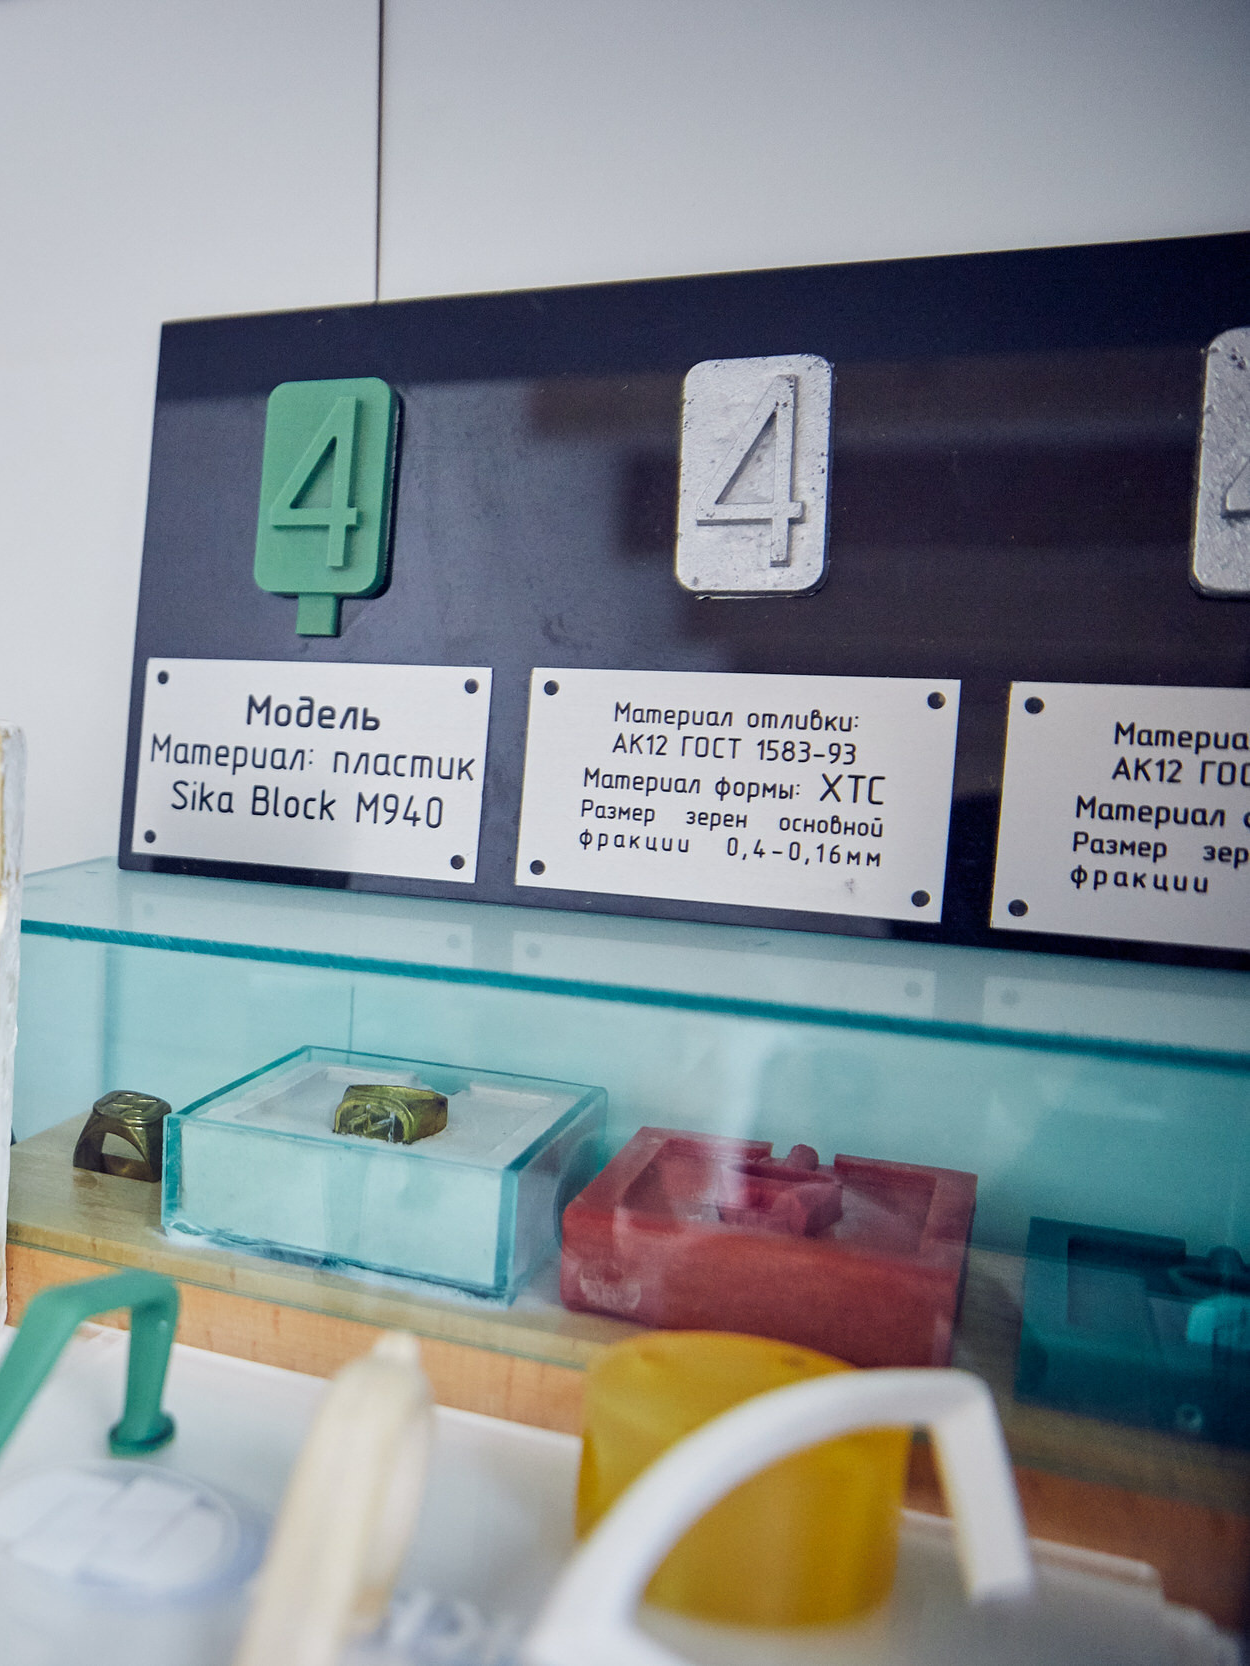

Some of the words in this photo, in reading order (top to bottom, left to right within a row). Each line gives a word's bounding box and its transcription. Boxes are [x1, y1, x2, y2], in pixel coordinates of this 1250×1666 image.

[270, 397, 358, 568] 4
[697, 375, 804, 567] 4
[247, 695, 380, 731] Модель
[615, 702, 732, 730] Материал
[748, 710, 858, 732] отливки:
[151, 734, 313, 775] Материал:
[333, 751, 475, 781] пластик
[612, 733, 667, 755] АК12
[682, 736, 742, 759] ГОСТ
[757, 740, 856, 765] 1583-93
[584, 767, 700, 796] Материал
[715, 777, 800, 803] формы:
[820, 774, 885, 805] ХТС
[1112, 757, 1182, 783] АК12
[171, 780, 234, 813] Sika
[252, 785, 335, 821] Block
[356, 792, 443, 828] M940
[581, 799, 655, 826] Размер
[686, 811, 747, 831] зерен
[780, 815, 883, 837] основной
[1076, 795, 1225, 829] Материал
[580, 829, 689, 852] фракции
[1073, 831, 1167, 863] Размер
[1071, 865, 1208, 893] фракции
